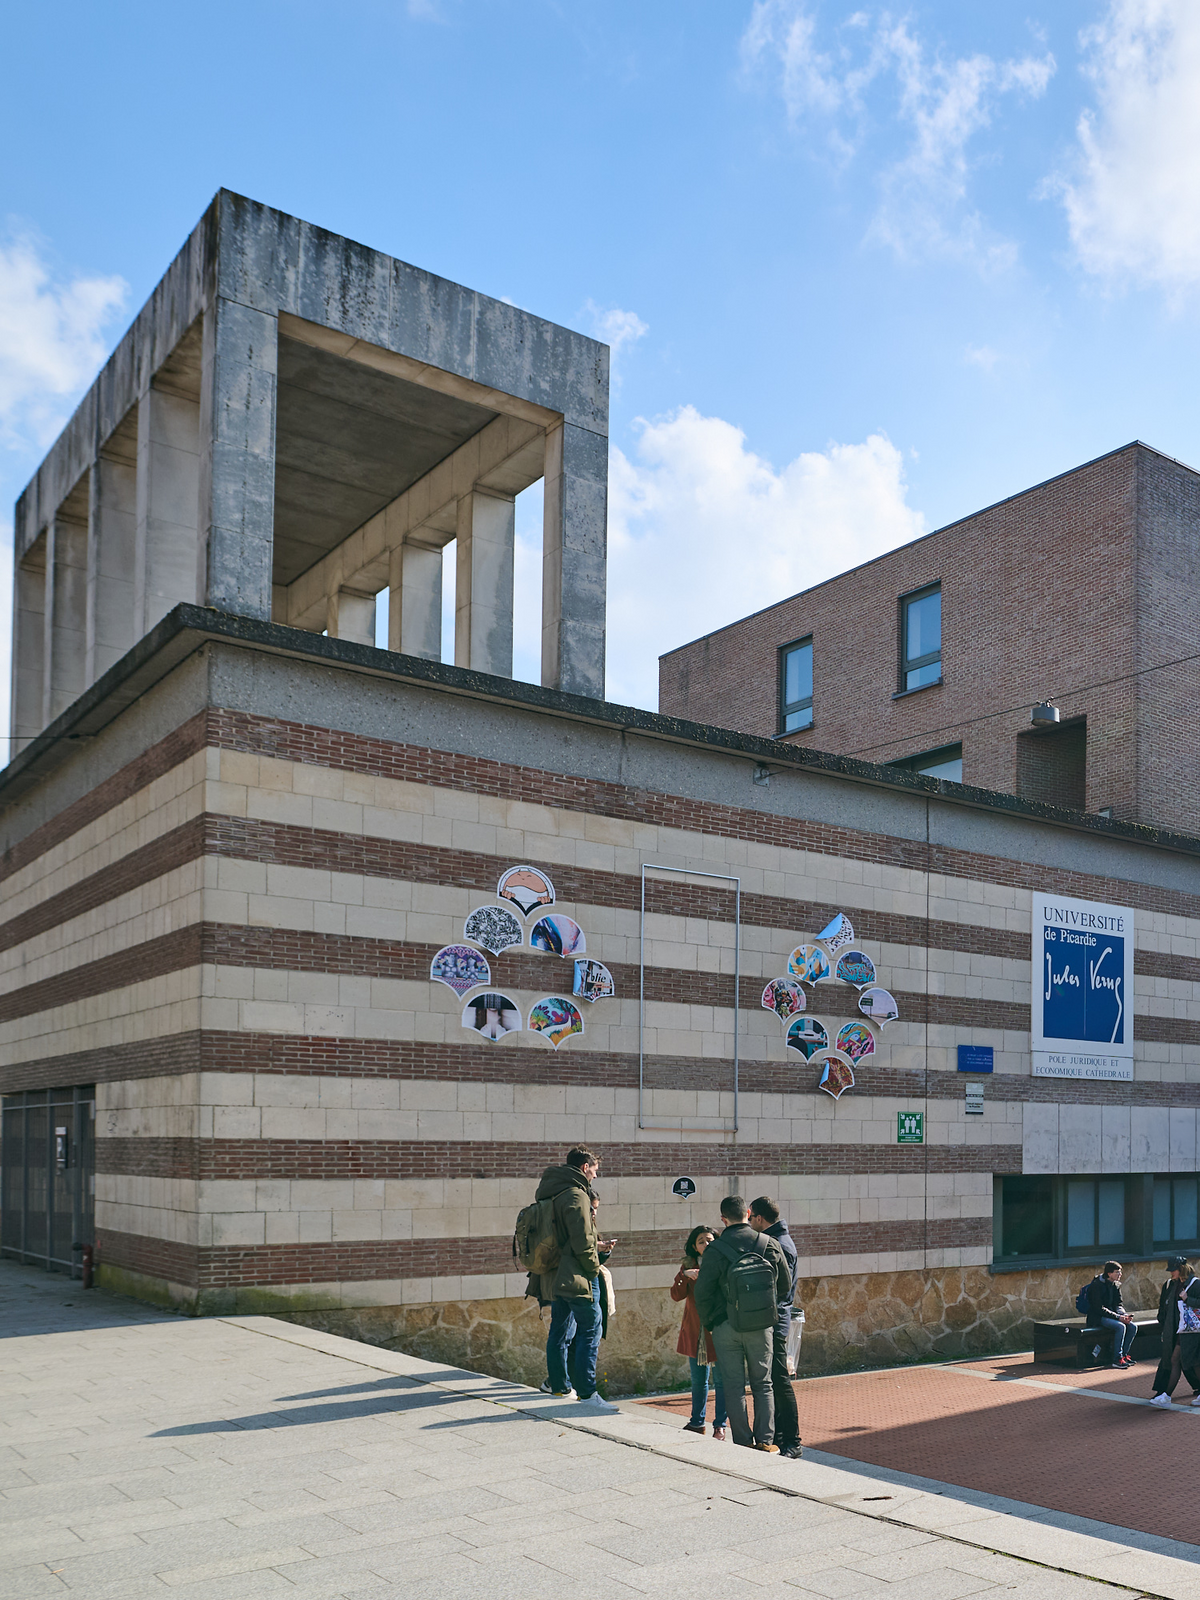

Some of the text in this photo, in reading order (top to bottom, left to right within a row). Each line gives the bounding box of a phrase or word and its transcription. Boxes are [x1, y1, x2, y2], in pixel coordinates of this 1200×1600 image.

[1043, 906, 1124, 932] UNIVERSITÉ
[1044, 927, 1097, 946] de Picardie
[1045, 946, 1122, 1044] Jules Verne
[1048, 1055, 1119, 1067] POLE JURIDIQUE ET
[1035, 1066, 1131, 1079] ECONOMIQUE CATHEDRALE
